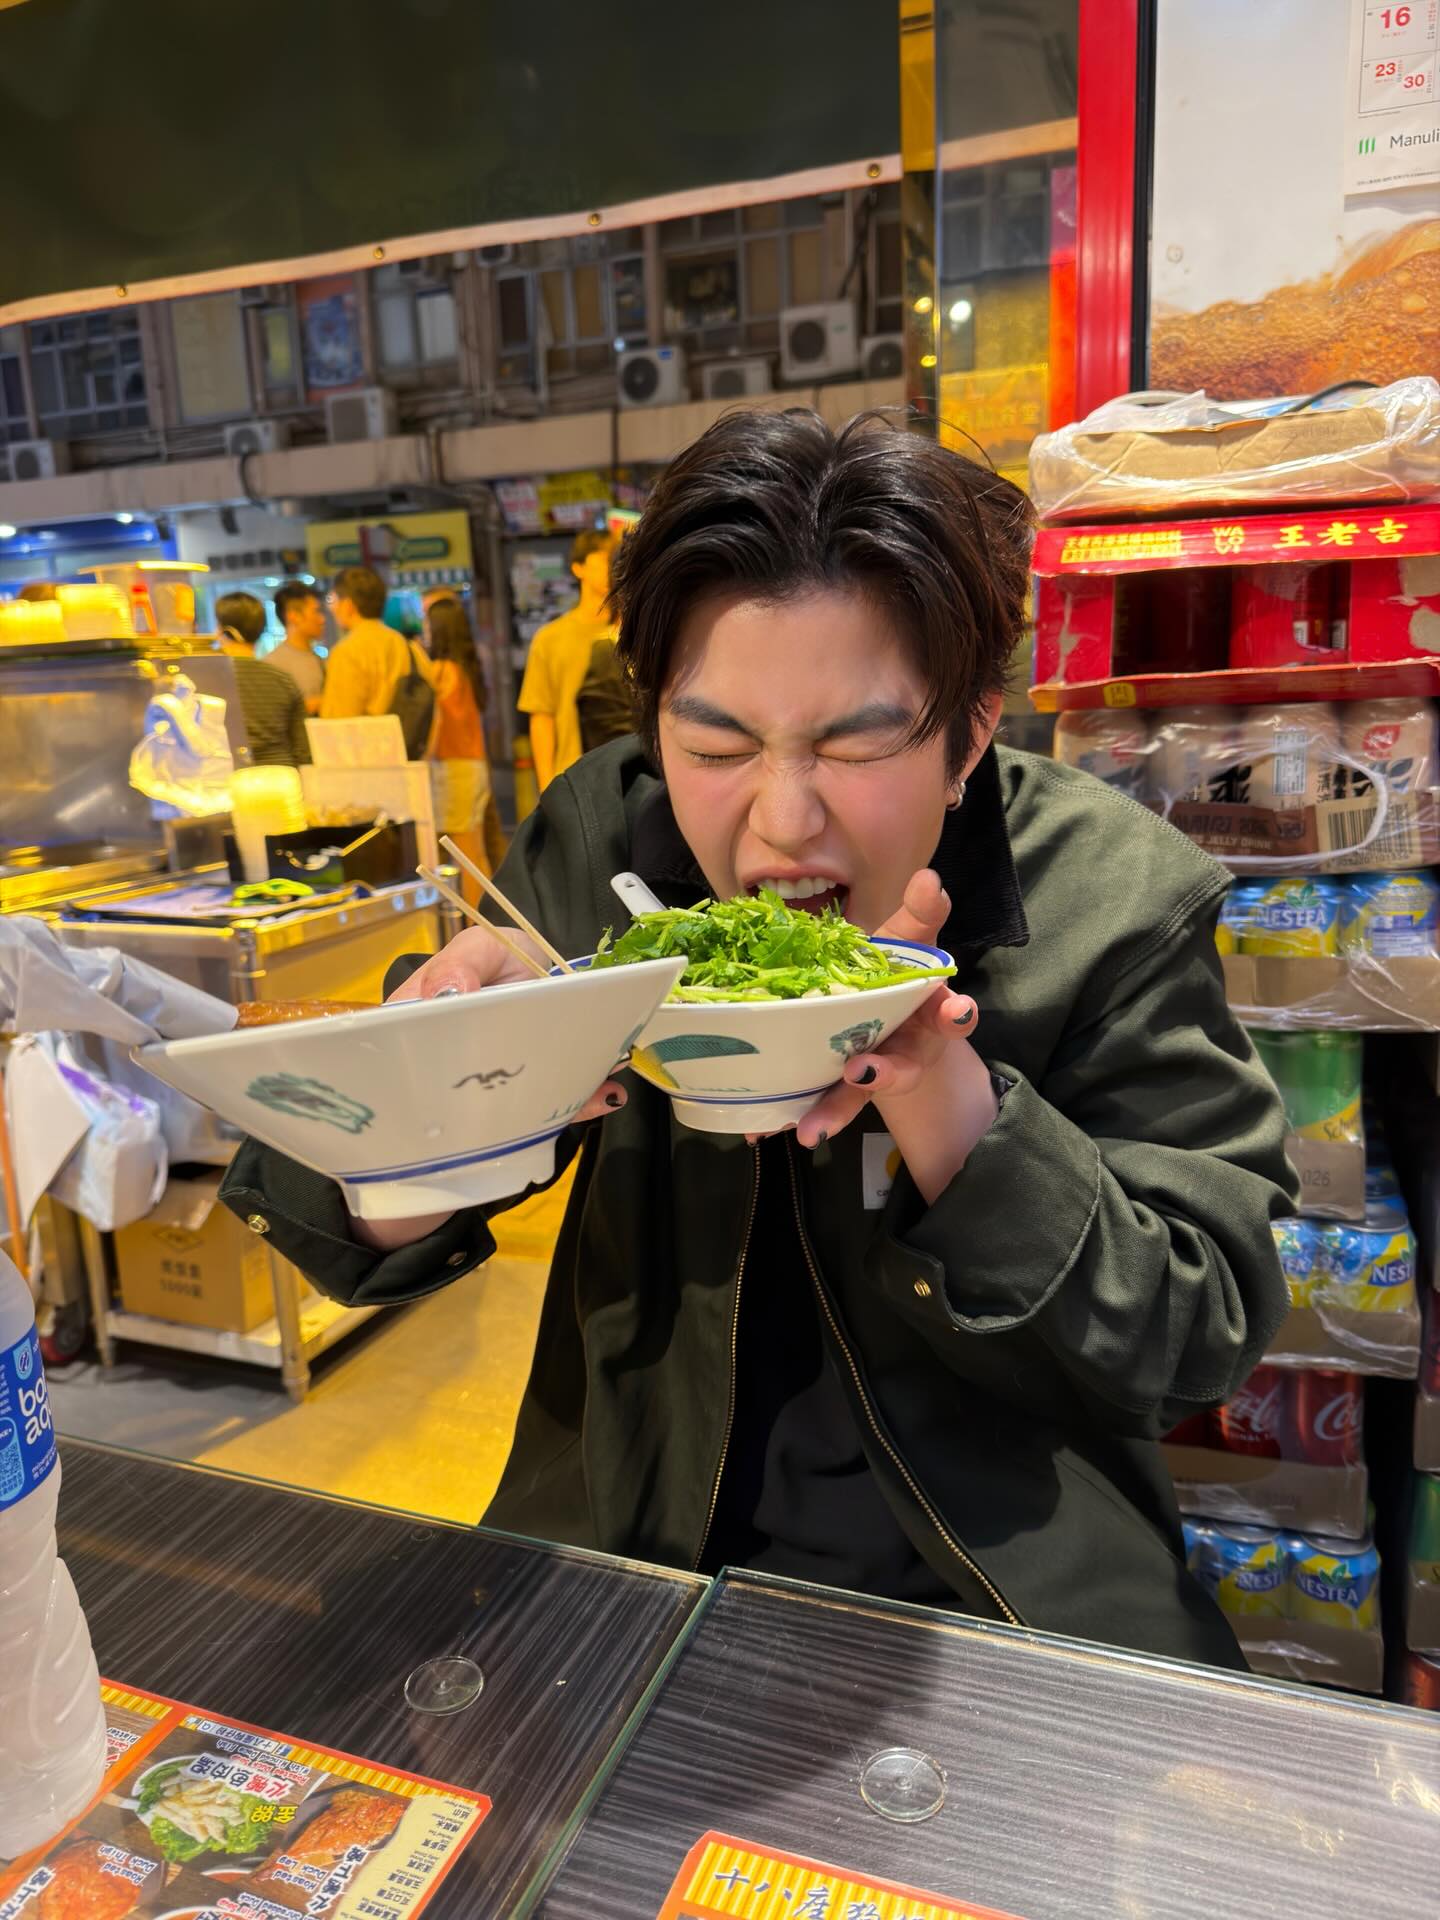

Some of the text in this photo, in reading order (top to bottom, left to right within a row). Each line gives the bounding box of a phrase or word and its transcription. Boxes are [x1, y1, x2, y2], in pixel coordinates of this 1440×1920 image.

[1380, 7, 1411, 29] 16
[1375, 62, 1396, 78] 23
[1403, 74, 1425, 89] 30
[1272, 518, 1408, 549] 王老吉
[1257, 907, 1328, 931] NESTEA
[1299, 1574, 1360, 1603] NESTEA
[103, 1862, 144, 1884] Roasted
[131, 1857, 155, 1873] Duck
[302, 1864, 326, 1880] Duck
